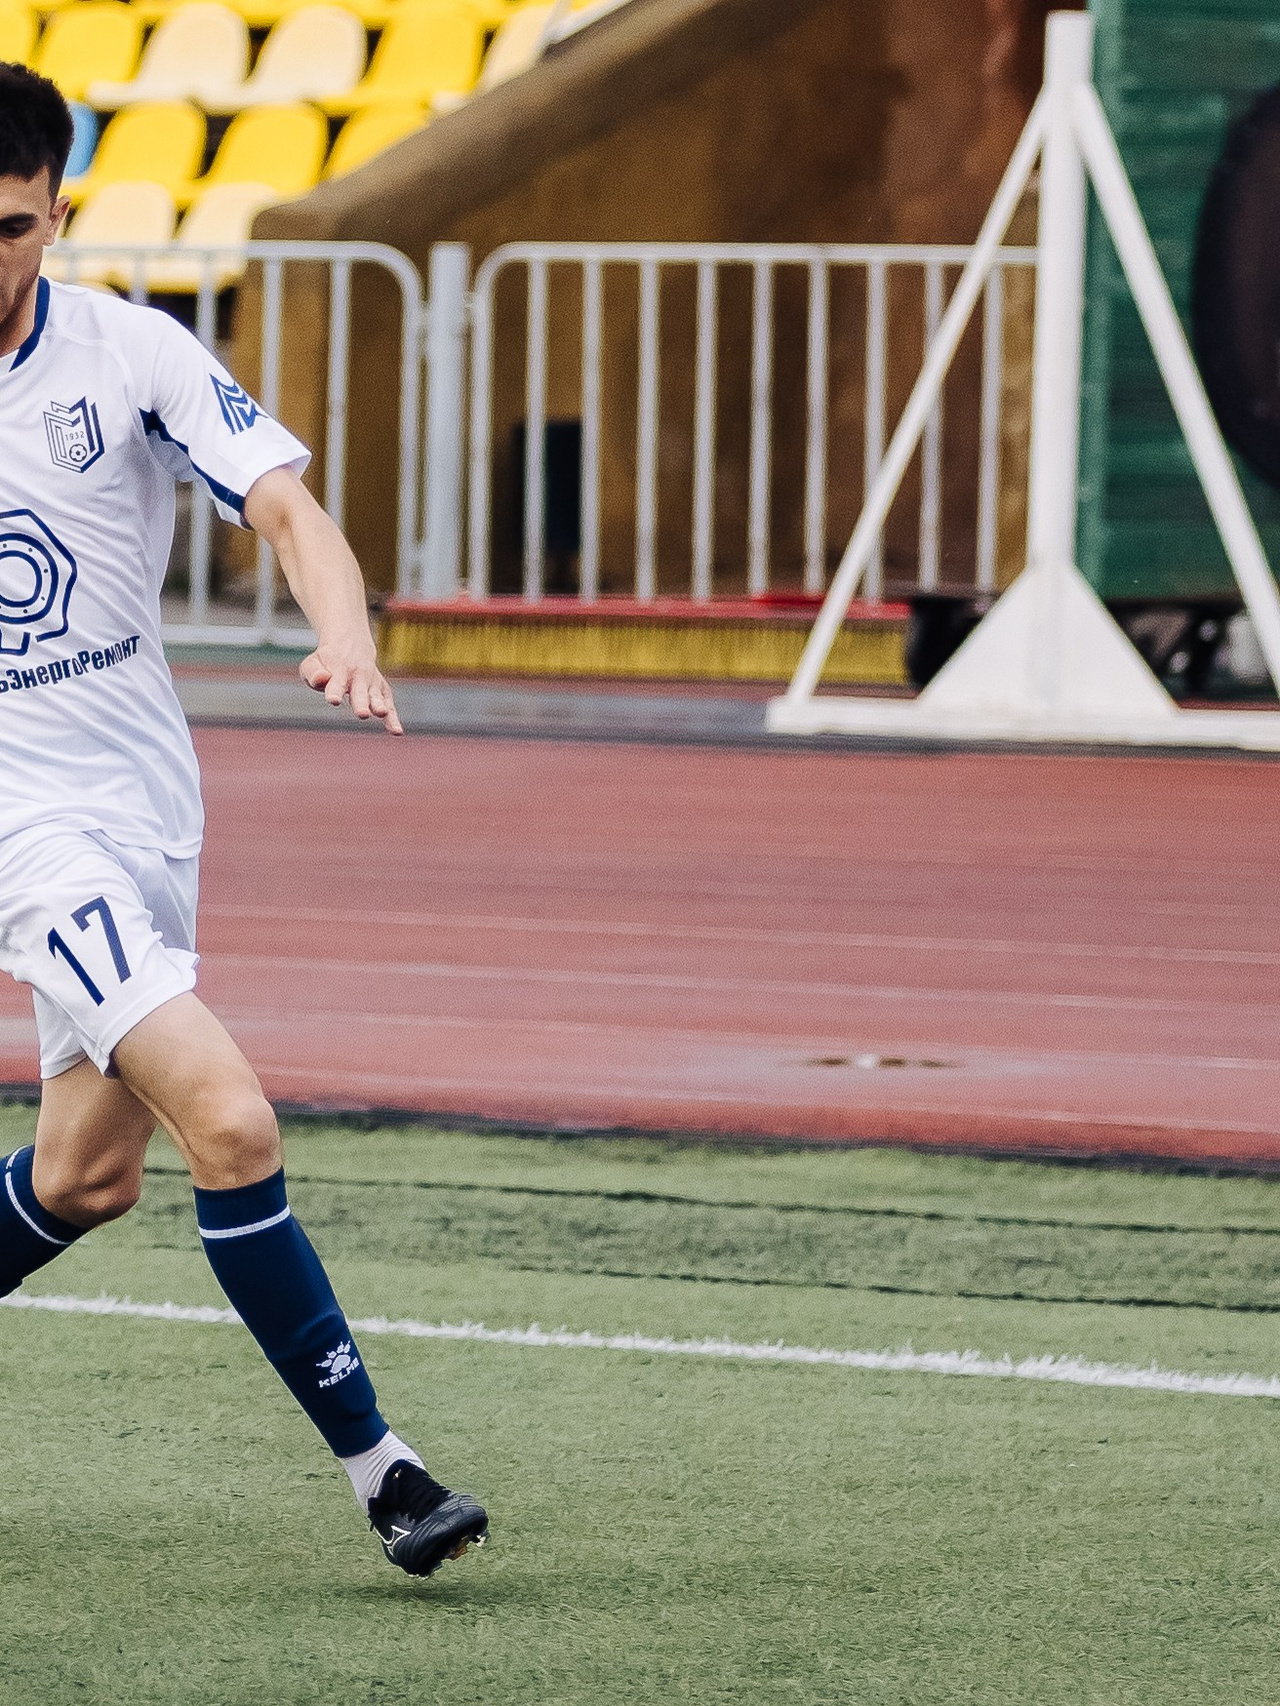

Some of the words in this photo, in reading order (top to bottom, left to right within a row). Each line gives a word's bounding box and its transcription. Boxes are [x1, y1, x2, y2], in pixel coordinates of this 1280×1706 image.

[64, 430, 85, 441] 1932
[47, 895, 132, 1007] 17
[318, 1356, 360, 1388] KELME
